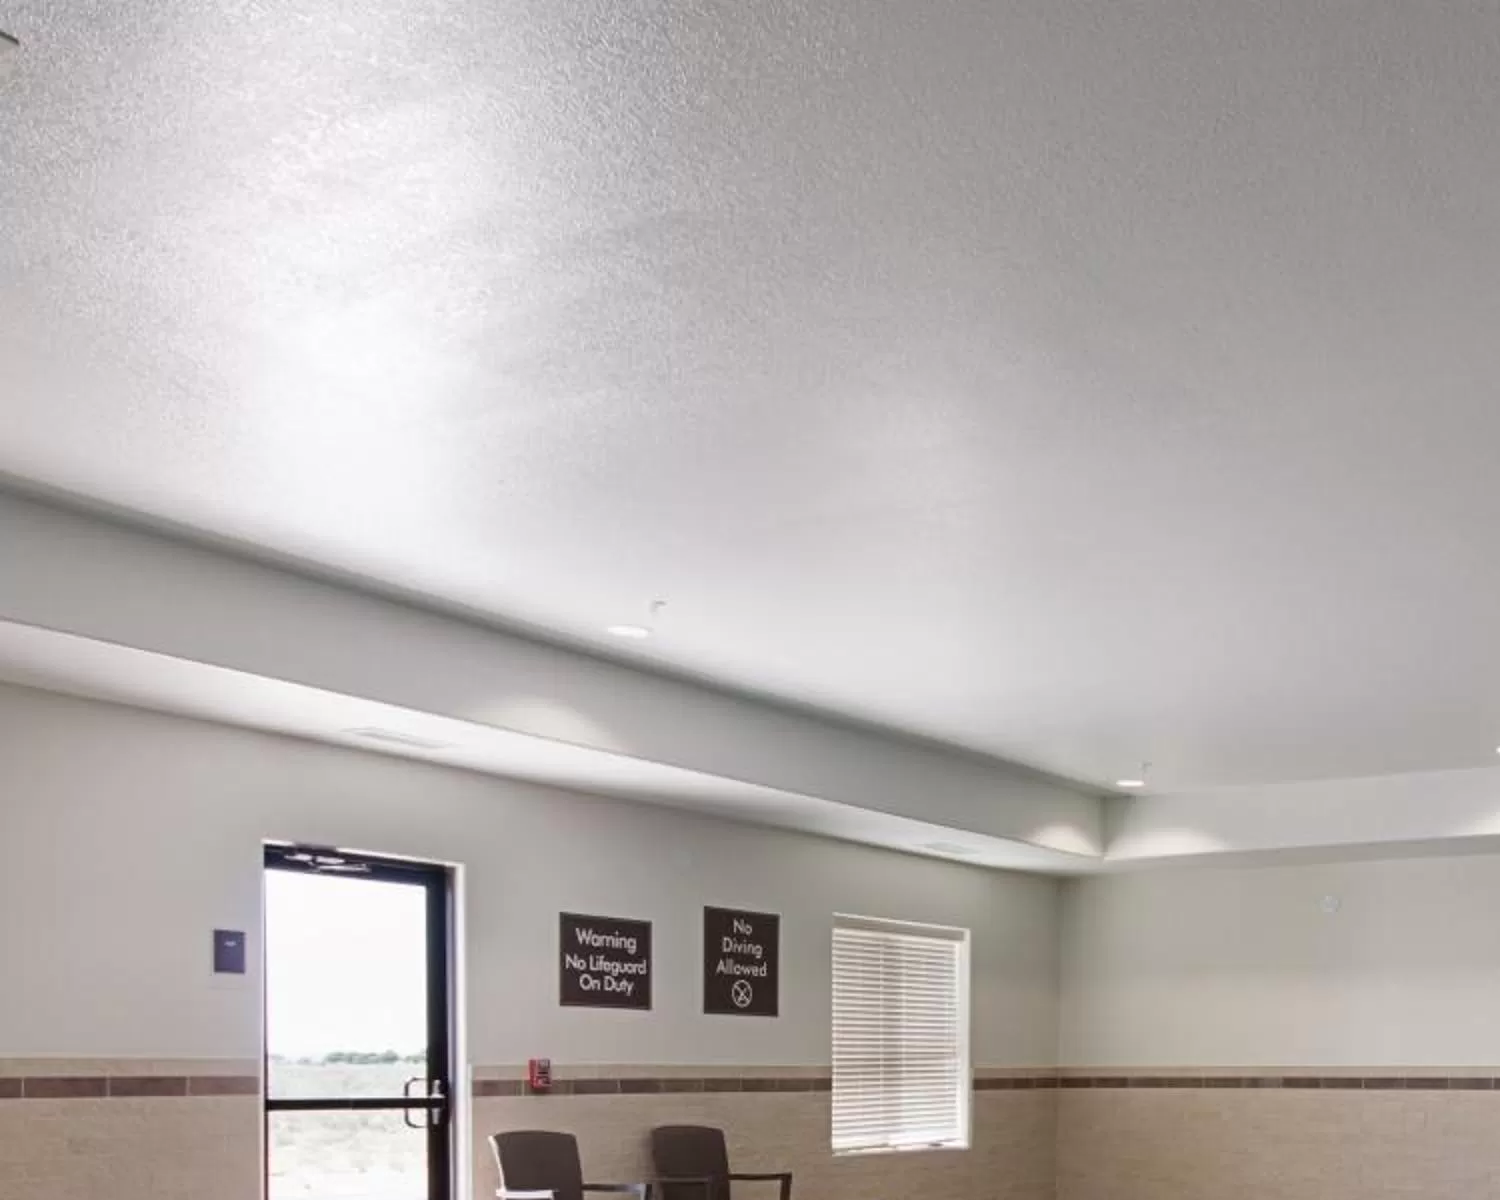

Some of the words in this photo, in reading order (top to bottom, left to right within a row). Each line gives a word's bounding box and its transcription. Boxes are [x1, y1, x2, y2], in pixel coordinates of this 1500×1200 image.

[733, 918, 752, 935] No
[575, 927, 637, 955] Warning
[722, 937, 763, 959] Diving
[565, 953, 587, 971] No
[589, 954, 647, 976] Lifeguard
[716, 958, 768, 977] Allowed
[579, 973, 601, 991] On
[603, 975, 634, 997] Duty
